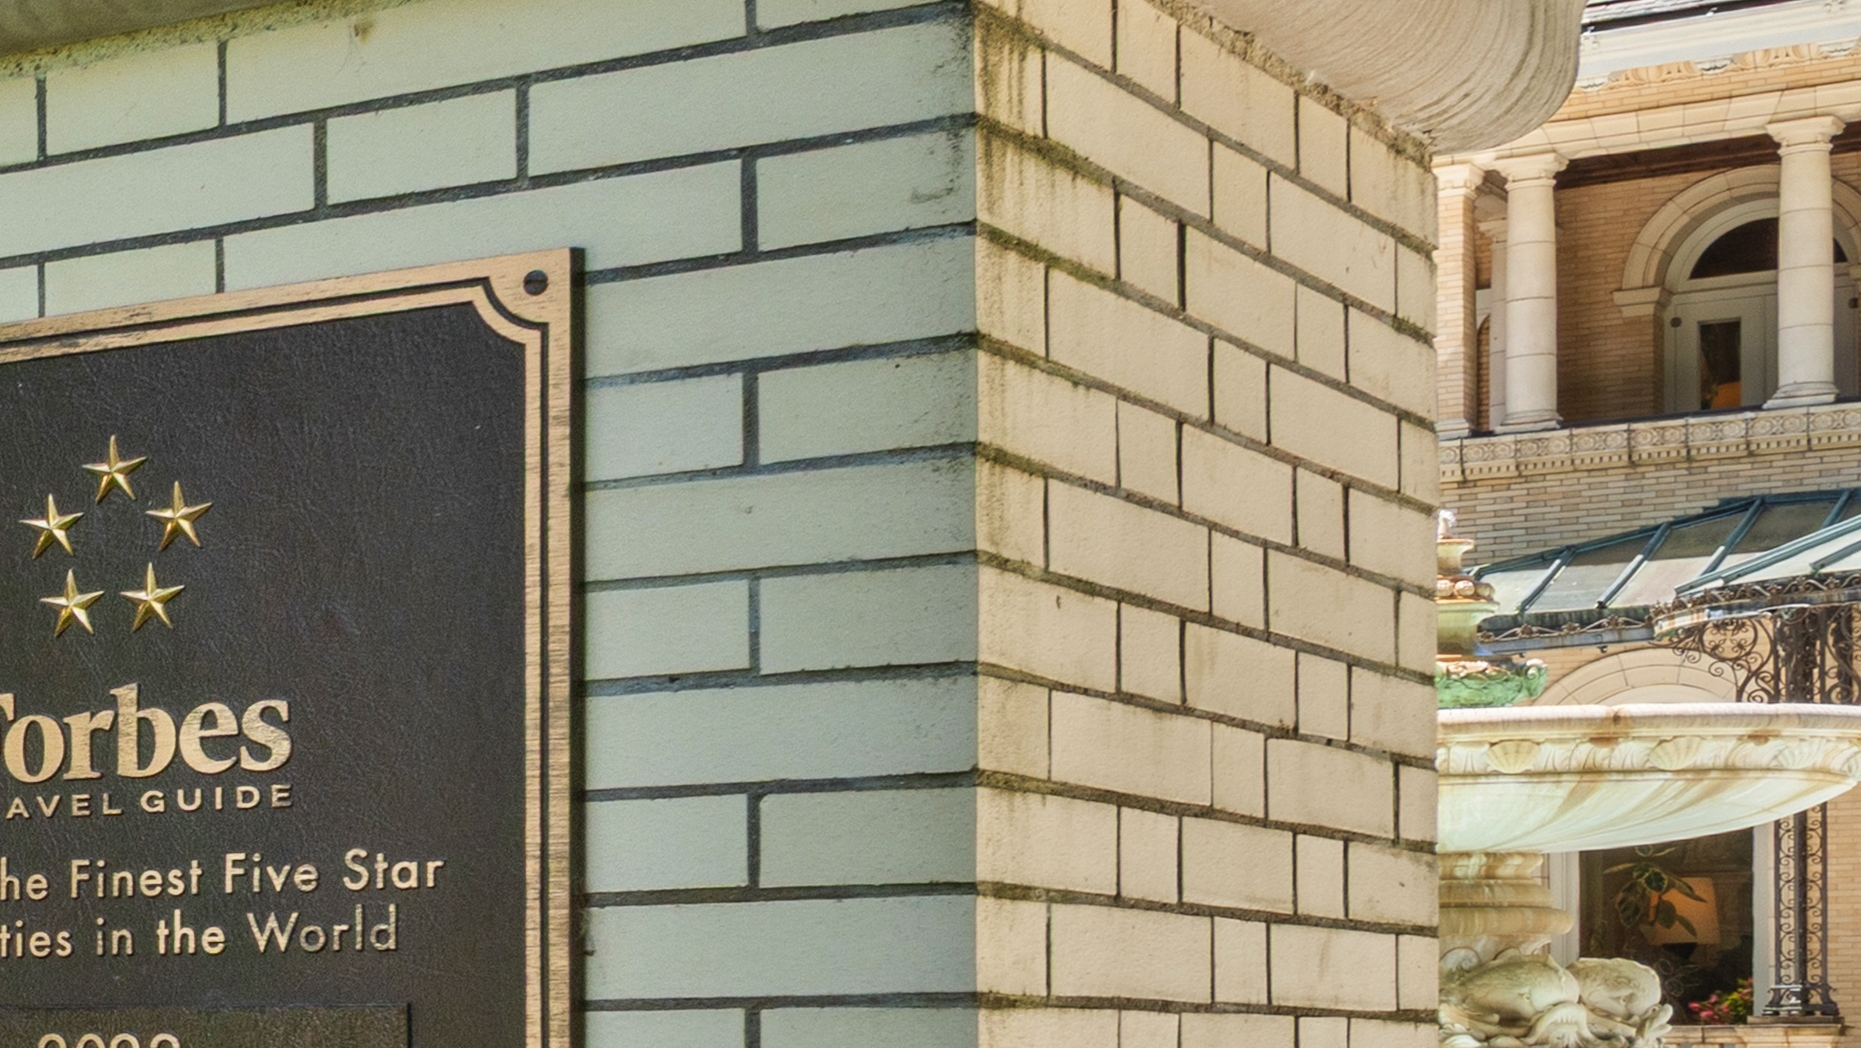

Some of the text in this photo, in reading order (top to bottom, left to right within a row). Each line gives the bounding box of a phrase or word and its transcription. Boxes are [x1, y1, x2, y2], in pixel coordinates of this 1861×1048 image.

[141, 784, 293, 814] GUIDE
[70, 859, 203, 899] Finest
[224, 852, 319, 893] Five
[342, 849, 445, 891] Star
[96, 918, 135, 956] in
[157, 910, 226, 955] the
[248, 905, 398, 954] World
